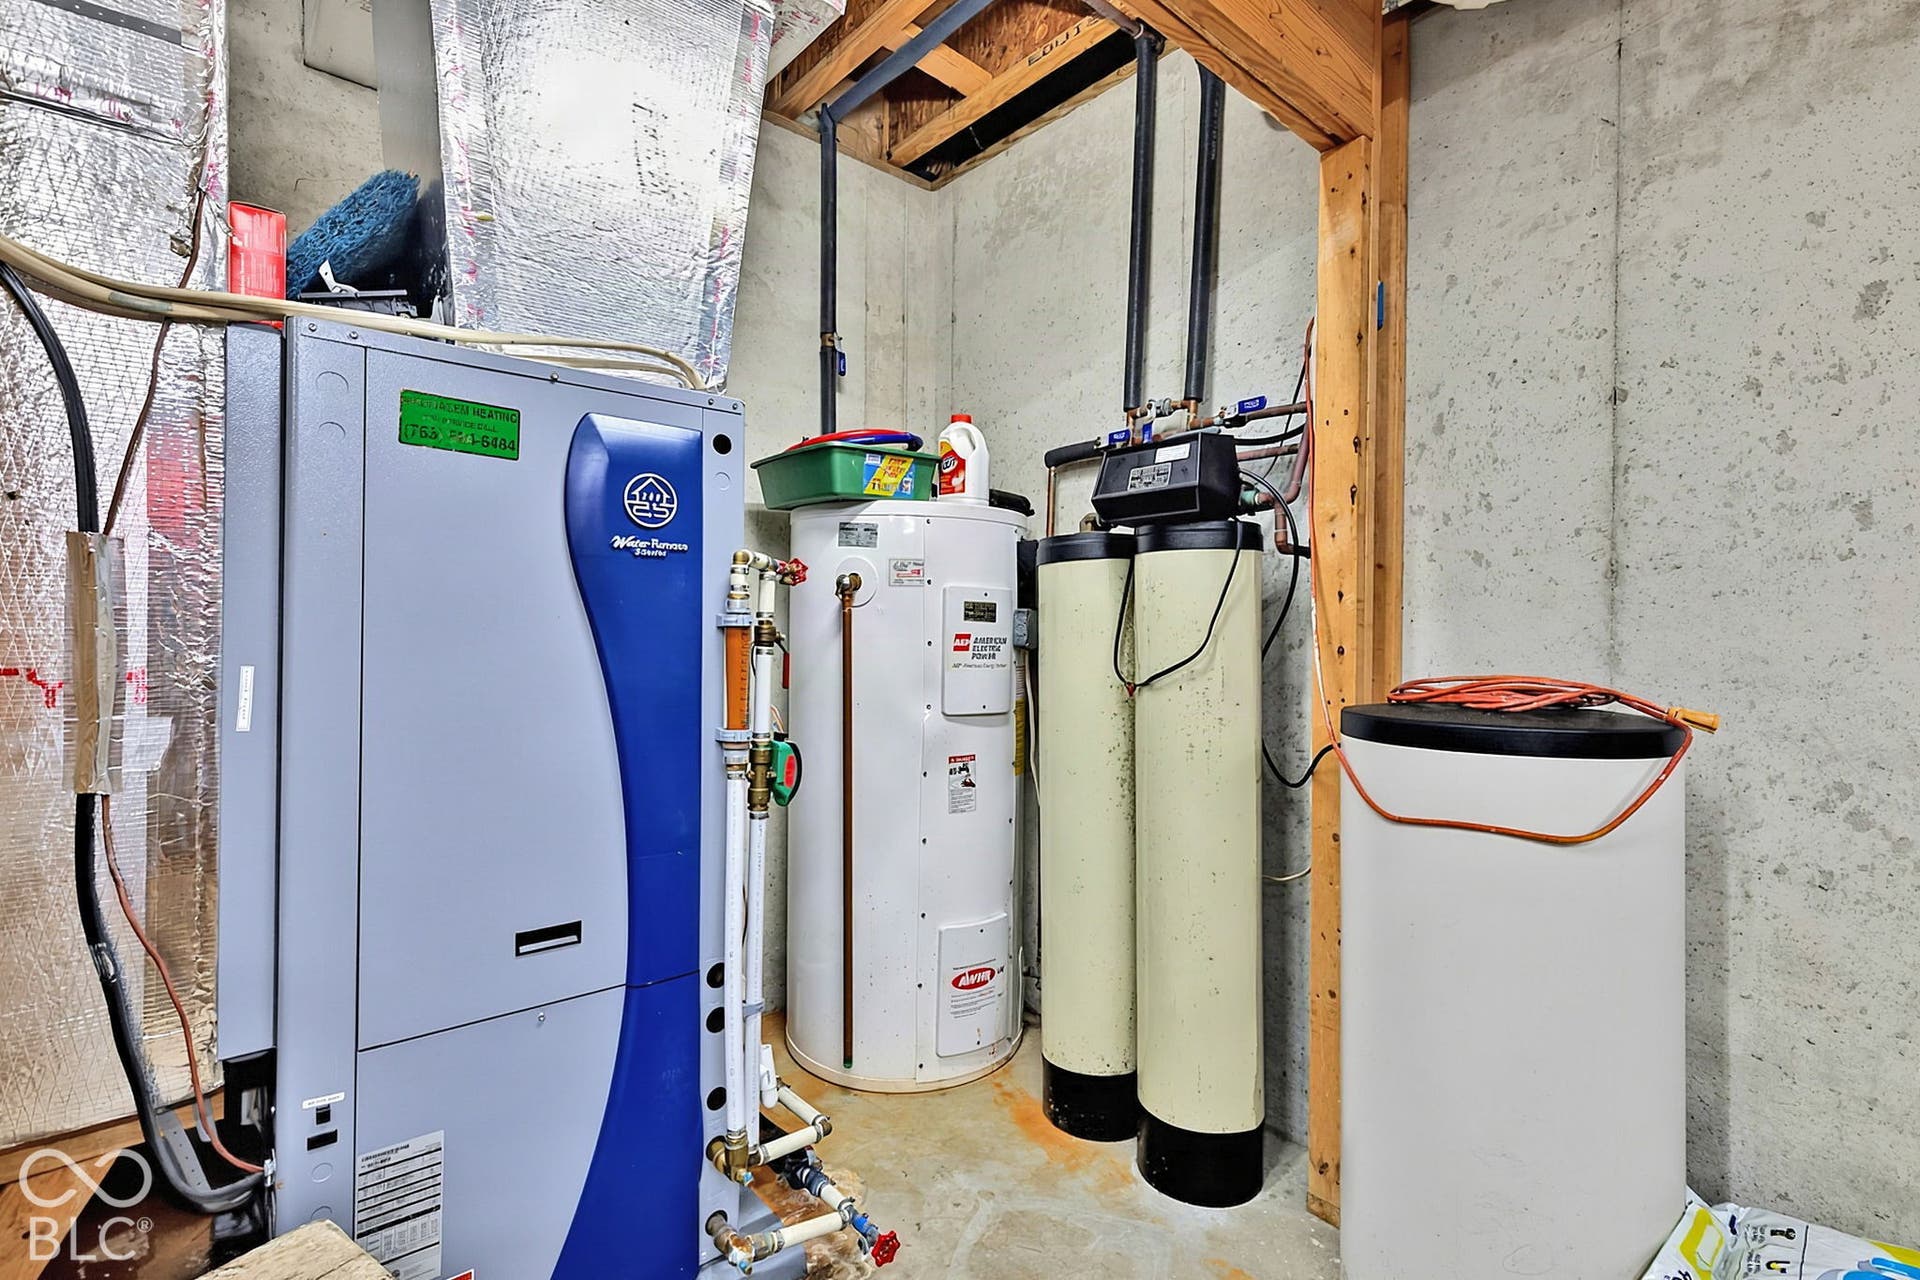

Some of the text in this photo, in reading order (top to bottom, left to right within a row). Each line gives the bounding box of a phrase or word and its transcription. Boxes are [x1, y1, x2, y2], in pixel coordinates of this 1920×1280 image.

[472, 407, 518, 424] HEATING
[972, 637, 1007, 645] AMERICAN
[971, 652, 997, 660] POWER
